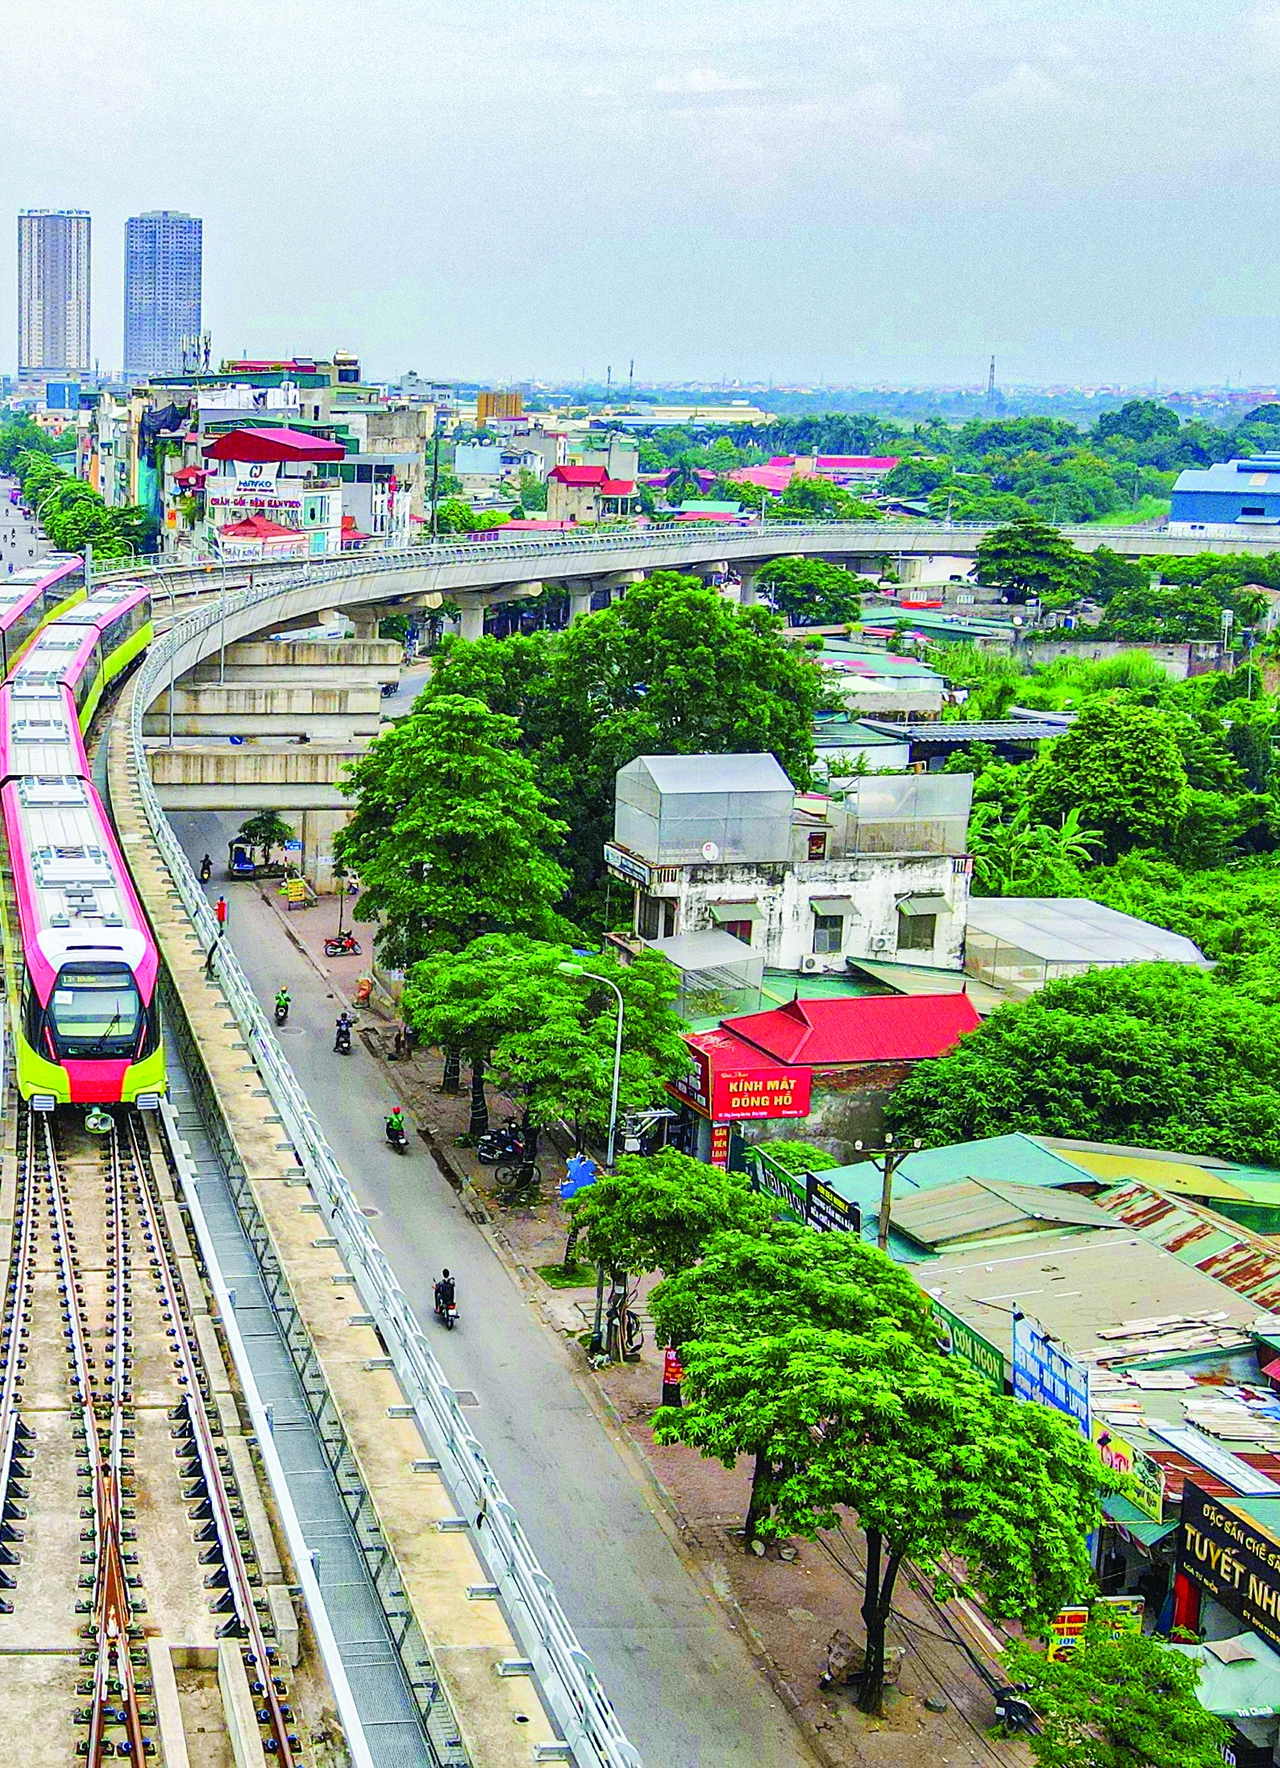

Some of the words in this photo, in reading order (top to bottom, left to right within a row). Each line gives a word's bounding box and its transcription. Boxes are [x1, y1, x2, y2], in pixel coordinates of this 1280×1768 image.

[729, 1078, 763, 1092] KÍNH
[766, 1076, 797, 1090] MẮT
[731, 1092, 770, 1107] ĐỒNG
[773, 1090, 792, 1106] HỒ
[974, 1341, 1001, 1381] NGON
[1202, 1503, 1223, 1527] ĐẶC
[1223, 1521, 1245, 1545] SẢN
[1184, 1522, 1247, 1589] TUYẾT
